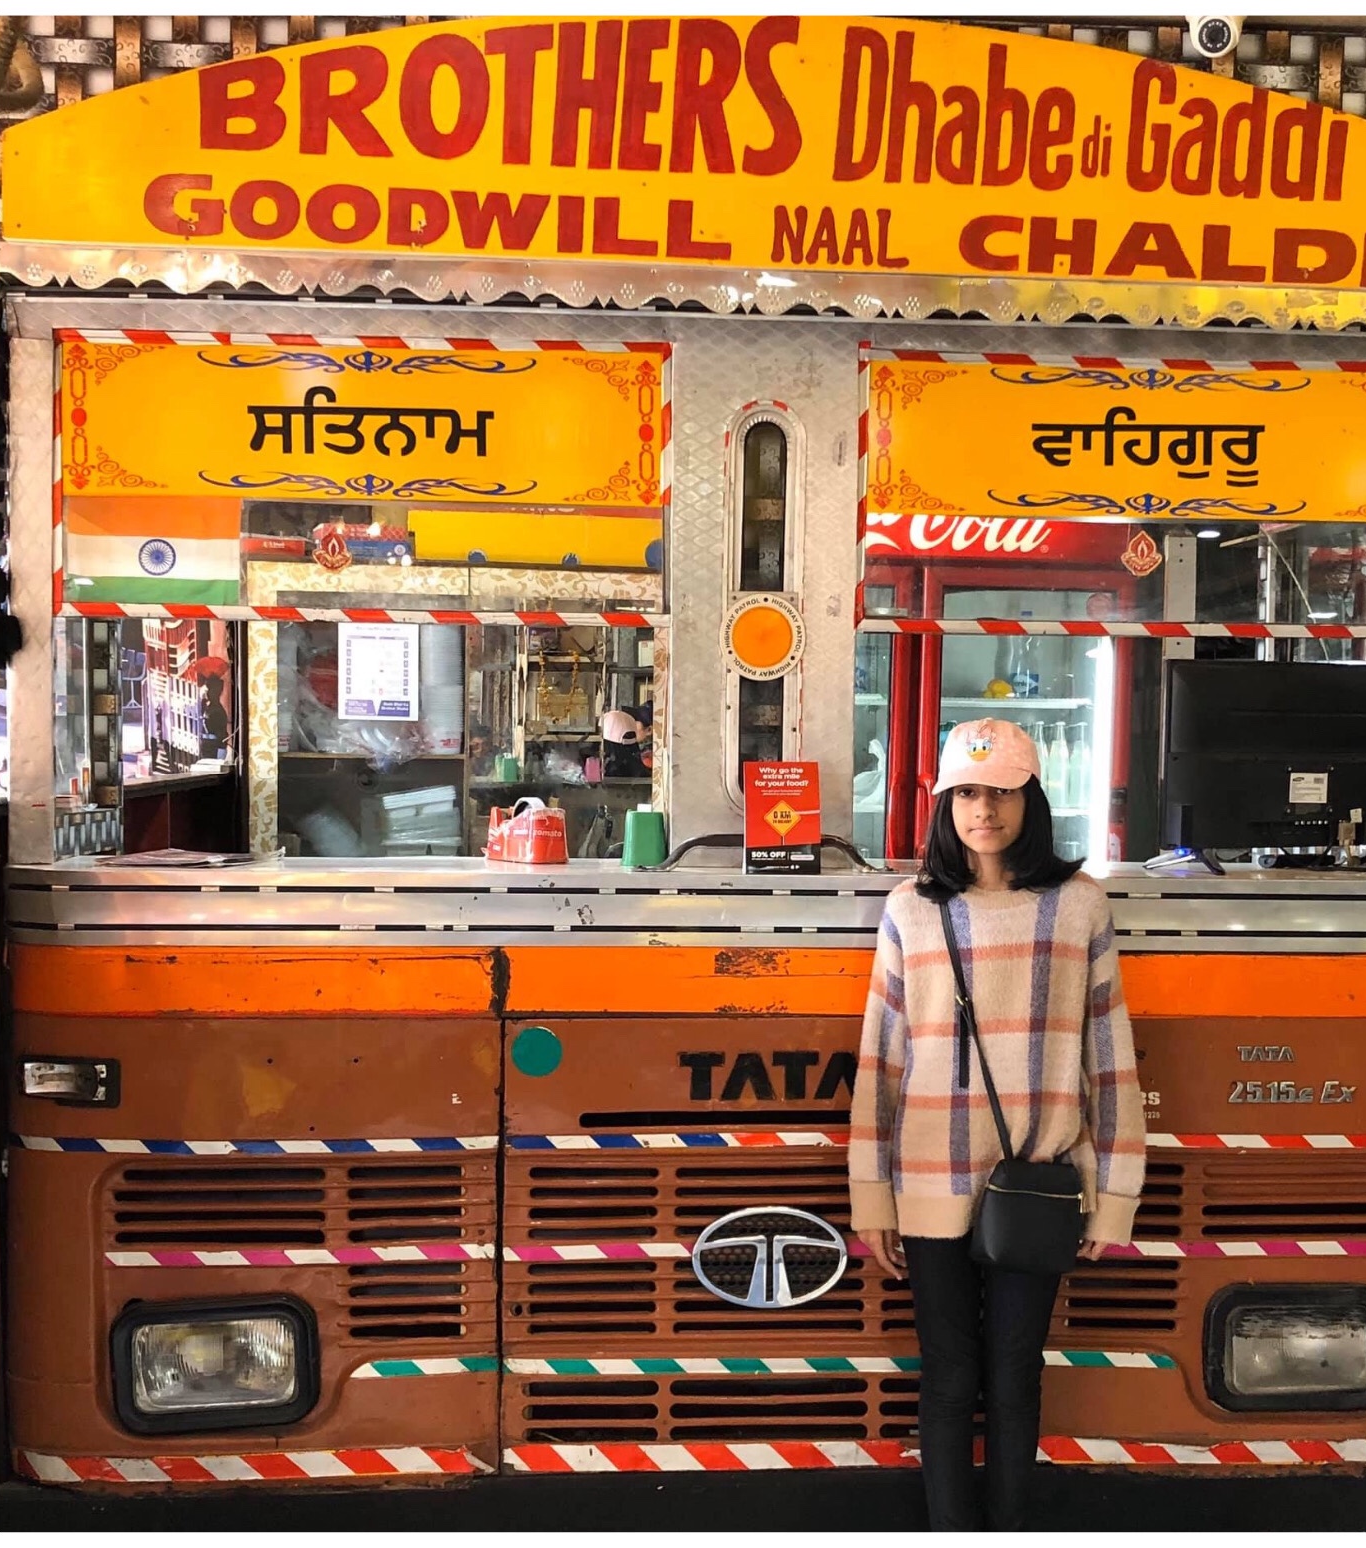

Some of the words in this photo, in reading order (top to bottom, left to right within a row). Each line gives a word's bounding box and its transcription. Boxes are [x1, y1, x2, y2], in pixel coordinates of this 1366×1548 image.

[199, 16, 803, 177] BROTHERS
[832, 26, 1076, 192] Dhabe
[1081, 115, 1112, 179] di
[1126, 57, 1349, 202] Gaddi
[143, 173, 732, 261] GOODWILL
[770, 204, 910, 269] NAAL
[247, 386, 494, 457] ਸਤਿਨਾਮ
[1031, 406, 1265, 487] ਵਾਹਿਗੁਰੂ
[724, 614, 736, 648] HIGHWAY
[735, 598, 760, 614] PATROL
[771, 598, 798, 623] HIGHWAY
[794, 625, 802, 652] PATROL
[733, 657, 756, 675] PATROL
[759, 661, 792, 677] HIGHWAY
[678, 1051, 859, 1101] TATA
[1237, 1046, 1294, 1062] TATA
